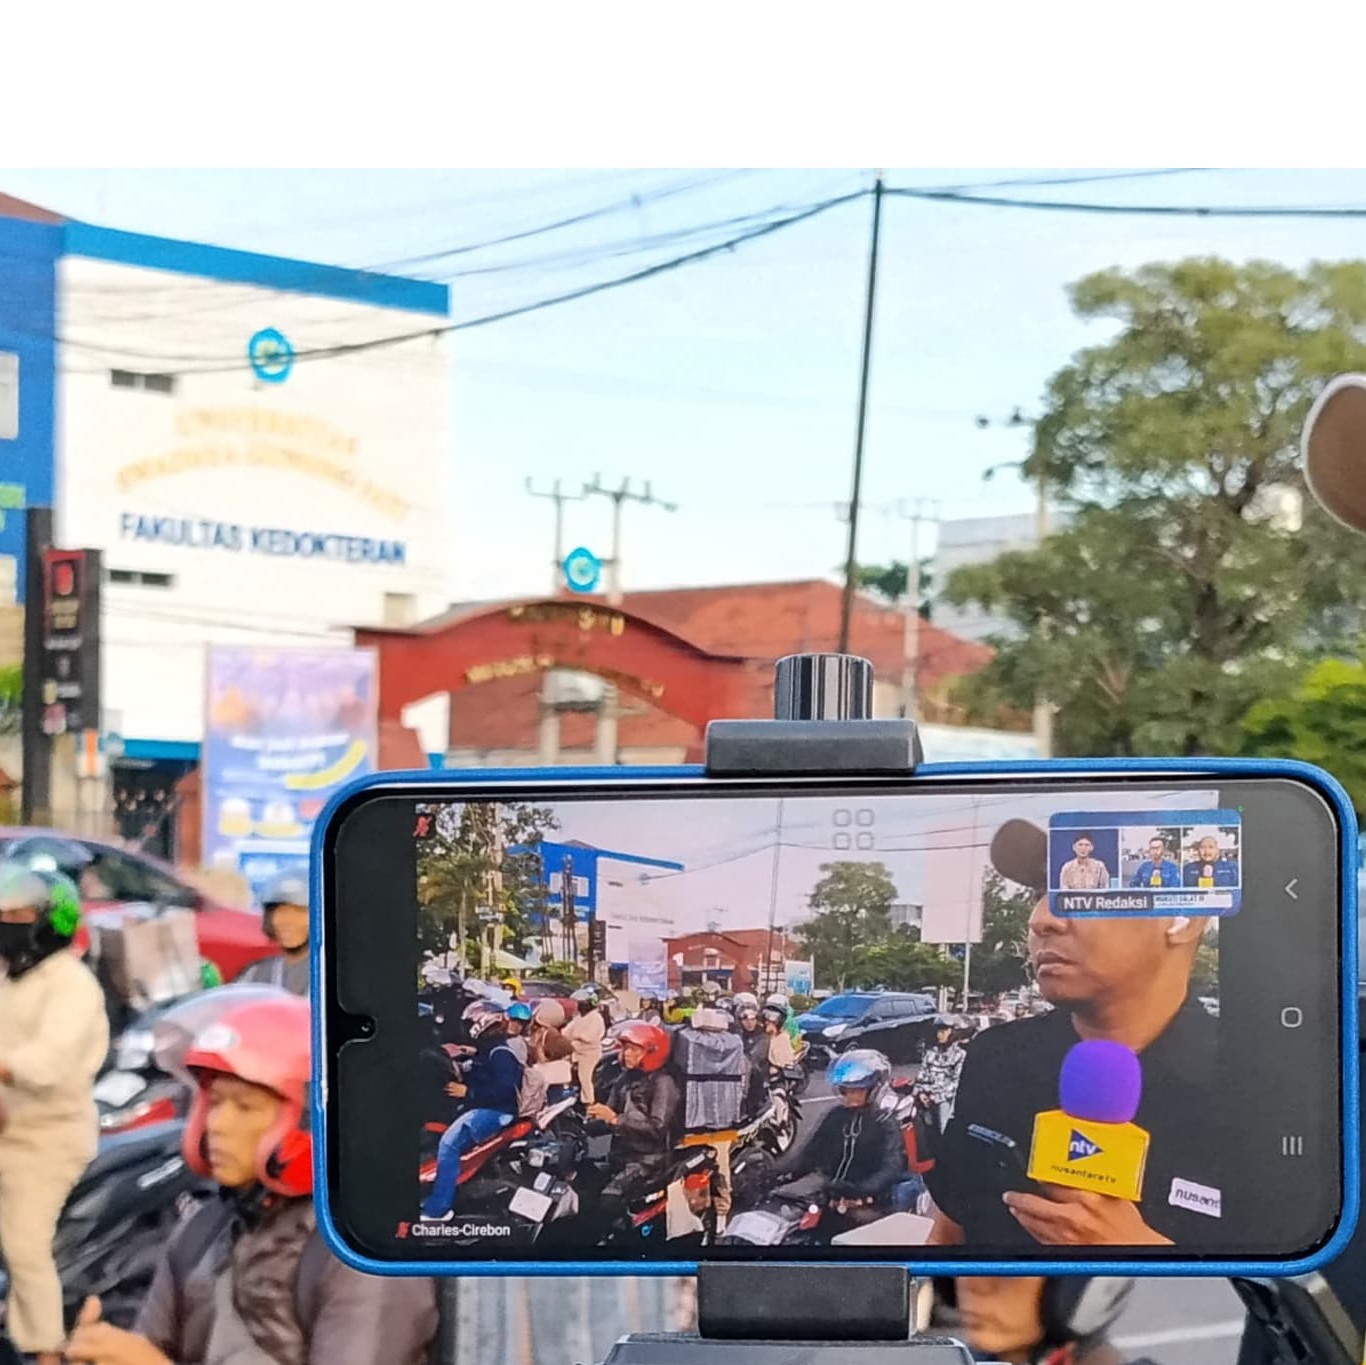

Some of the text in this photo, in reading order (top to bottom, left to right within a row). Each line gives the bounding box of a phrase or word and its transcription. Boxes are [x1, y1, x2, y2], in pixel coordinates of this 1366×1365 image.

[120, 511, 407, 566] FAKULTAS KEDOKTERAN
[1063, 897, 1092, 910] NTV
[1095, 896, 1148, 910] Redaksi
[1069, 1139, 1097, 1155] ntv
[411, 1223, 511, 1237] Charles-Cirebon
